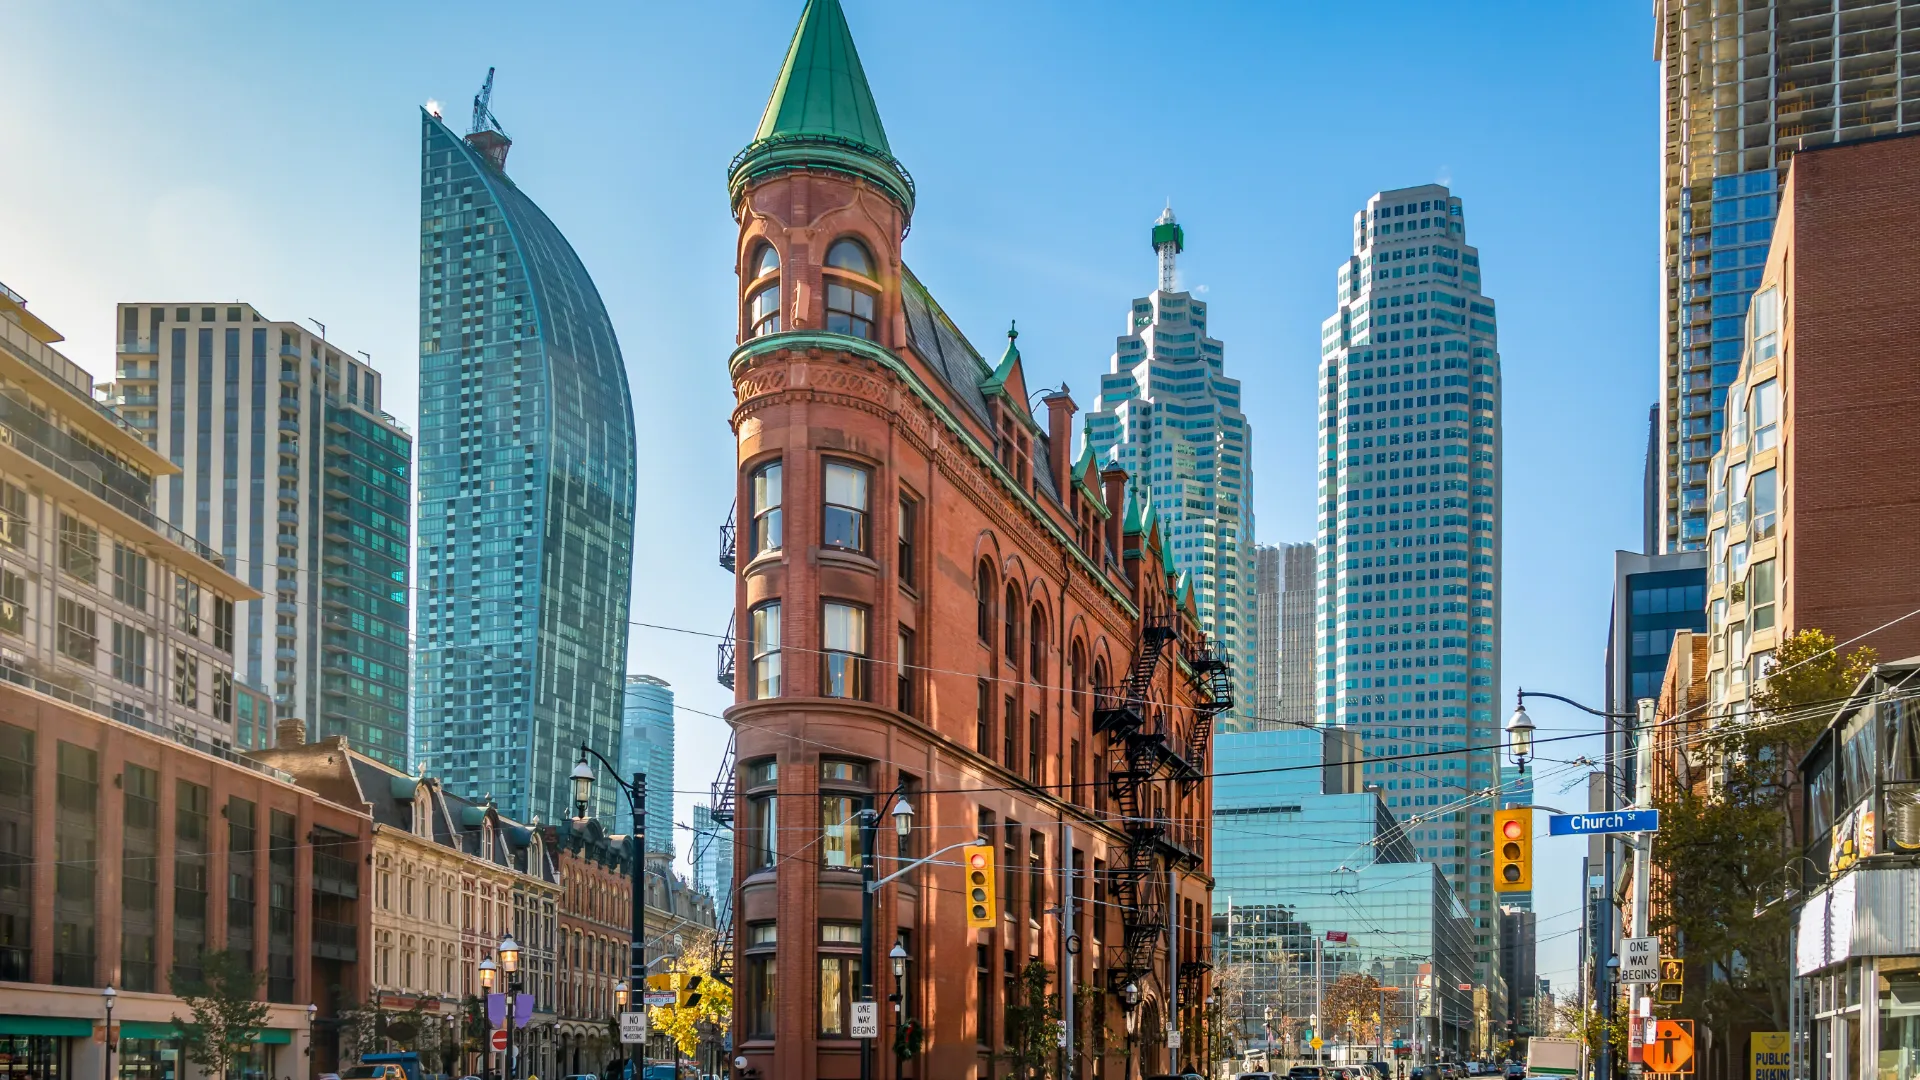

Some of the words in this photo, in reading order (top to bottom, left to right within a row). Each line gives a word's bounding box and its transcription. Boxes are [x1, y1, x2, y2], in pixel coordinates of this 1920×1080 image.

[1570, 814, 1623, 830] Church
[1627, 813, 1636, 821] St
[1630, 941, 1649, 952] ONE
[1630, 955, 1649, 966] WAY
[1623, 969, 1657, 980] BEGINS
[858, 1005, 870, 1013] ONE
[630, 1016, 638, 1024] NO
[853, 1026, 875, 1034] BEGINS
[1756, 1052, 1790, 1065] PUBLIC
